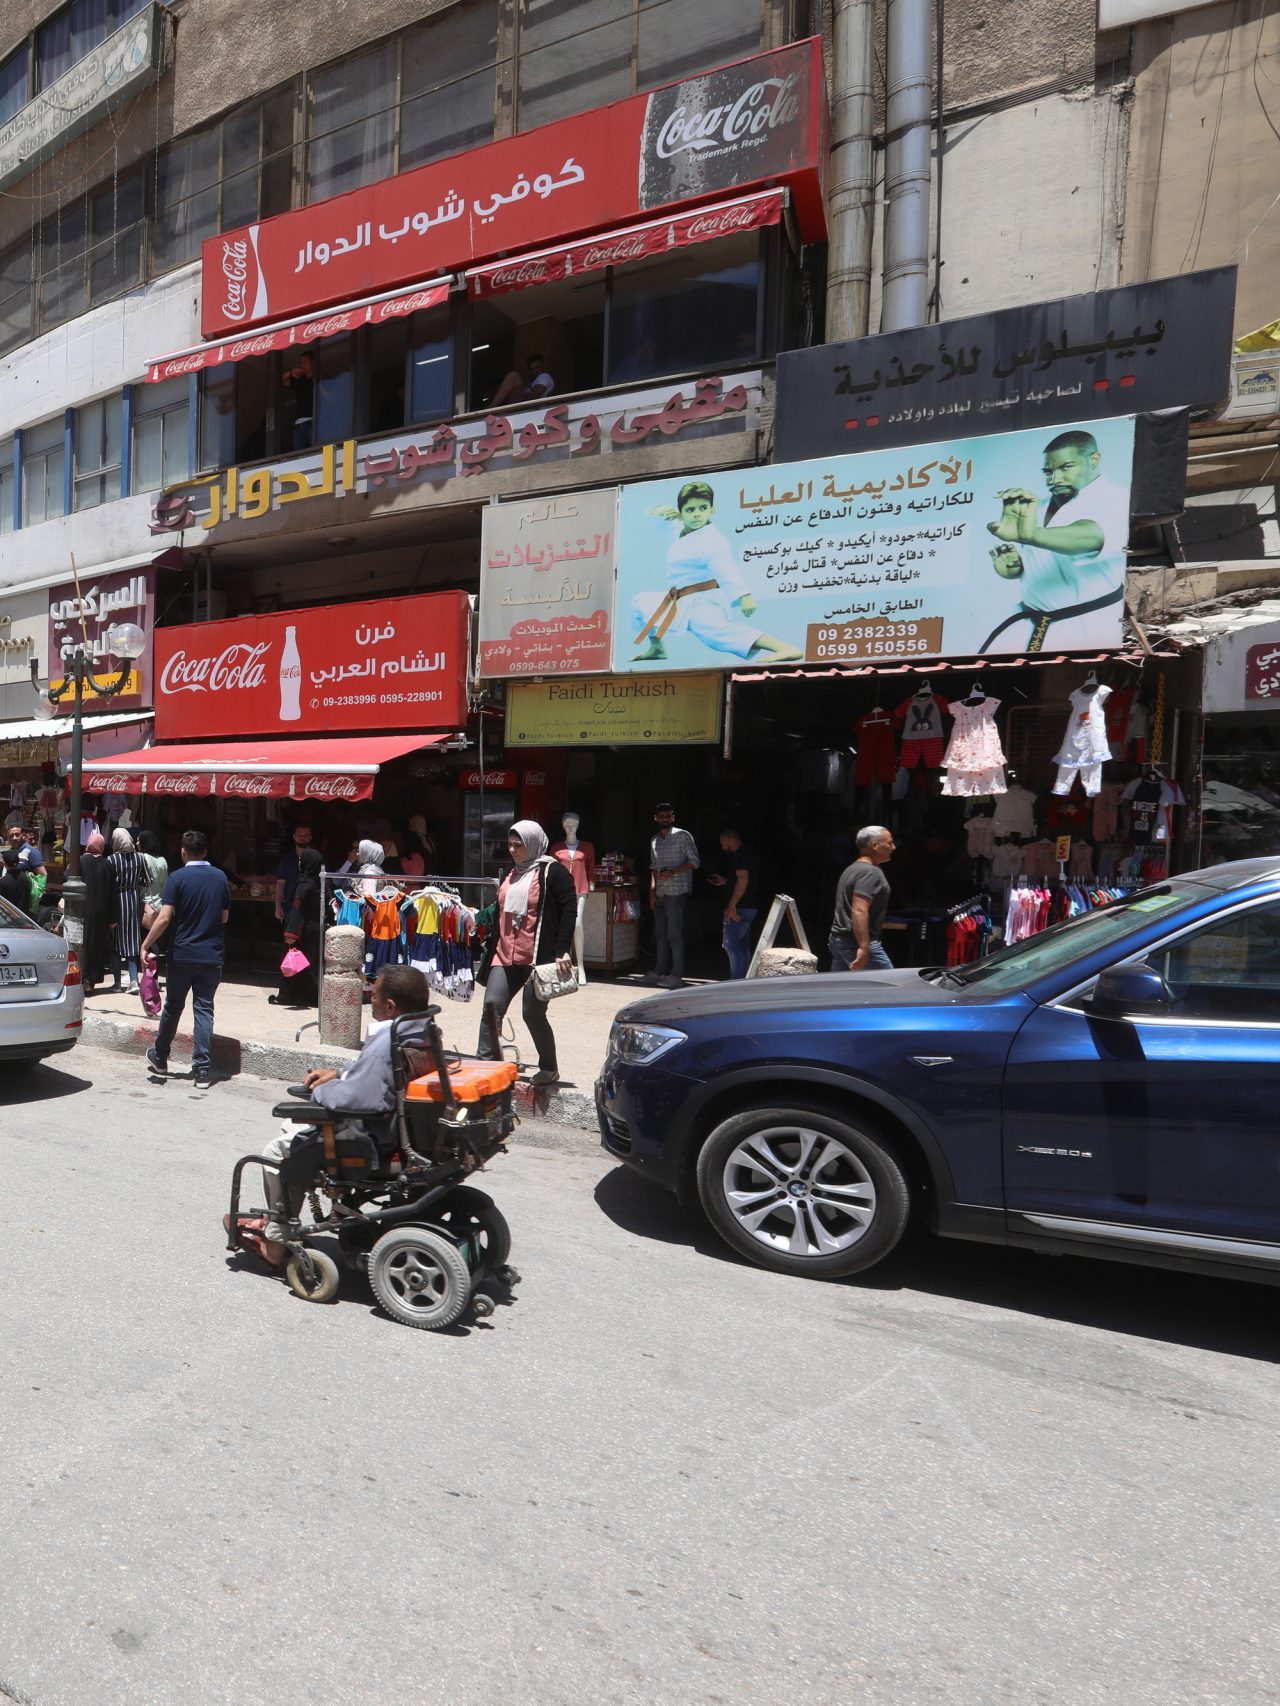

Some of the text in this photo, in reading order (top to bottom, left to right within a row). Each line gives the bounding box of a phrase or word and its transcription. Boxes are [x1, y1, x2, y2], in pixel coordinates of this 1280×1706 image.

[656, 70, 802, 159] Coca-Cola
[688, 144, 739, 163] Trademark
[294, 157, 585, 273] كوفي شوب الدوار
[491, 203, 756, 289] Coca-Cola Coca-Cola Coca-Cola
[221, 238, 248, 321] Coca-Cola
[164, 289, 432, 376] Coca-Cola Coca-Cola Coca-Cola Coca-Cola
[833, 318, 1166, 403] بيبلوس للأحذية
[611, 375, 749, 444] مقهى
[459, 403, 571, 478] كوفي
[363, 423, 457, 485] شوب
[200, 439, 358, 531] الدوار
[738, 455, 974, 514] الأكاديمية العليا
[734, 491, 975, 534] للكاراتيه وفنون الدفاع عن النفس
[742, 543, 792, 562] بوكسينج
[796, 538, 824, 554] كيك
[839, 531, 876, 552] أيكيدو
[766, 560, 799, 578] شوارع
[802, 556, 827, 572] قتال
[876, 554, 894, 565] عن
[897, 550, 924, 567] دفاع
[778, 580, 798, 593] وزن
[824, 598, 924, 619] الطابق الخامس
[355, 621, 396, 646] فرن
[516, 616, 602, 638] أحدث الموديلات
[817, 623, 919, 641] 09 2382339
[484, 639, 607, 660] ستاتي بناتي ولادي
[817, 639, 929, 657] 0599 150556
[160, 641, 273, 695] Coca-Cola
[309, 649, 446, 688] الشام العربي
[509, 659, 580, 673] 0599-643 075
[322, 690, 443, 708] 09-2383996 0595-228901
[548, 680, 677, 701] Faidi Turkish
[88, 774, 359, 797] Coca-Cola Coca-Cola Coca-Cola Coca-Cola
